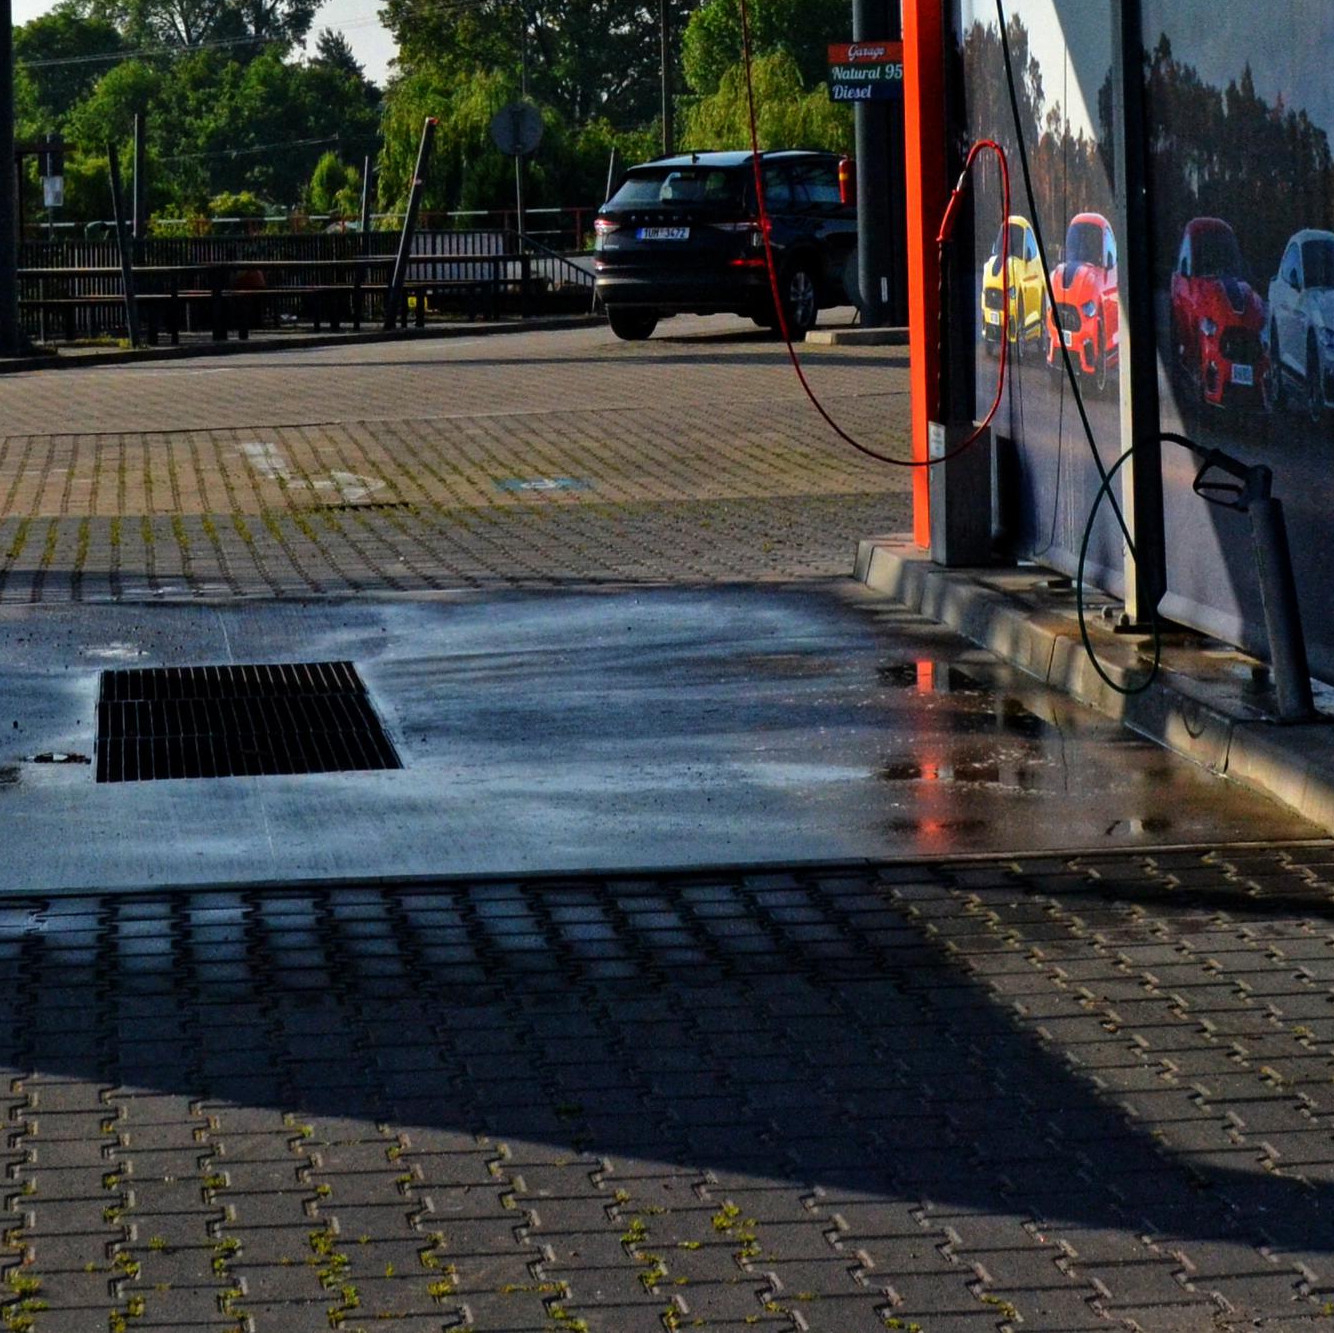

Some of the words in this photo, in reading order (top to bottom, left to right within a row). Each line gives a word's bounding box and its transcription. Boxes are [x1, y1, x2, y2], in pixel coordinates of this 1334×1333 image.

[848, 44, 885, 61] Garage
[831, 66, 881, 80] Natural
[884, 63, 903, 80] 95
[831, 84, 872, 99] Diesel
